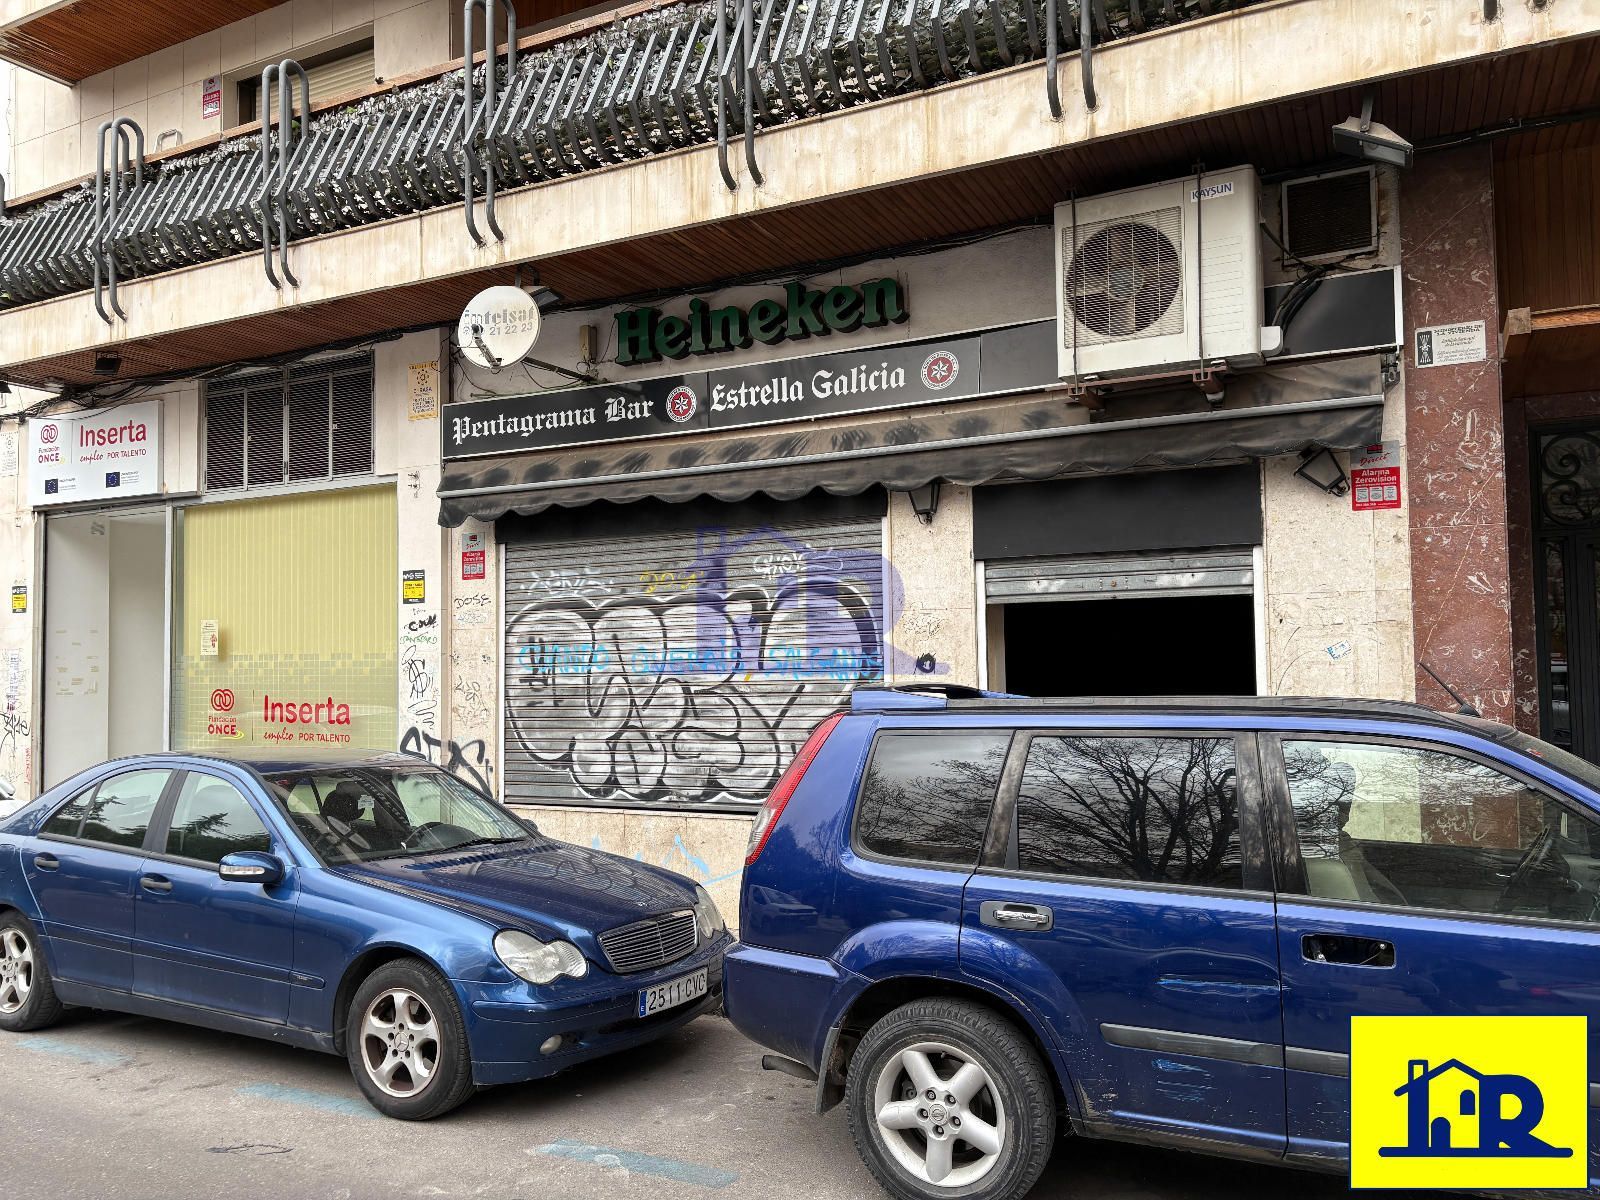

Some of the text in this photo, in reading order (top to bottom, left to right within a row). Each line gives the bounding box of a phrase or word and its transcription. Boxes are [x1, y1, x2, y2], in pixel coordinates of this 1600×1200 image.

[1192, 183, 1232, 199] KAYSUN
[489, 321, 533, 336] 21 22 23
[615, 277, 906, 365] Heineken
[710, 377, 804, 412] Estrella
[811, 362, 906, 399] Galicia
[452, 407, 596, 445] Pentagrama
[605, 396, 654, 423] Bar
[80, 420, 147, 447] Inserta
[38, 453, 60, 463] ONCE
[80, 450, 104, 464] empleo
[120, 448, 147, 458] TALENTO
[1355, 475, 1397, 484] Zerovision
[1361, 469, 1390, 477] Alarma
[263, 695, 351, 725] Inserta
[208, 715, 237, 723] Fundación
[207, 724, 237, 735] ONCE
[263, 727, 351, 744] empleo POR TALENTO
[648, 973, 705, 1012] 2511 CVC
